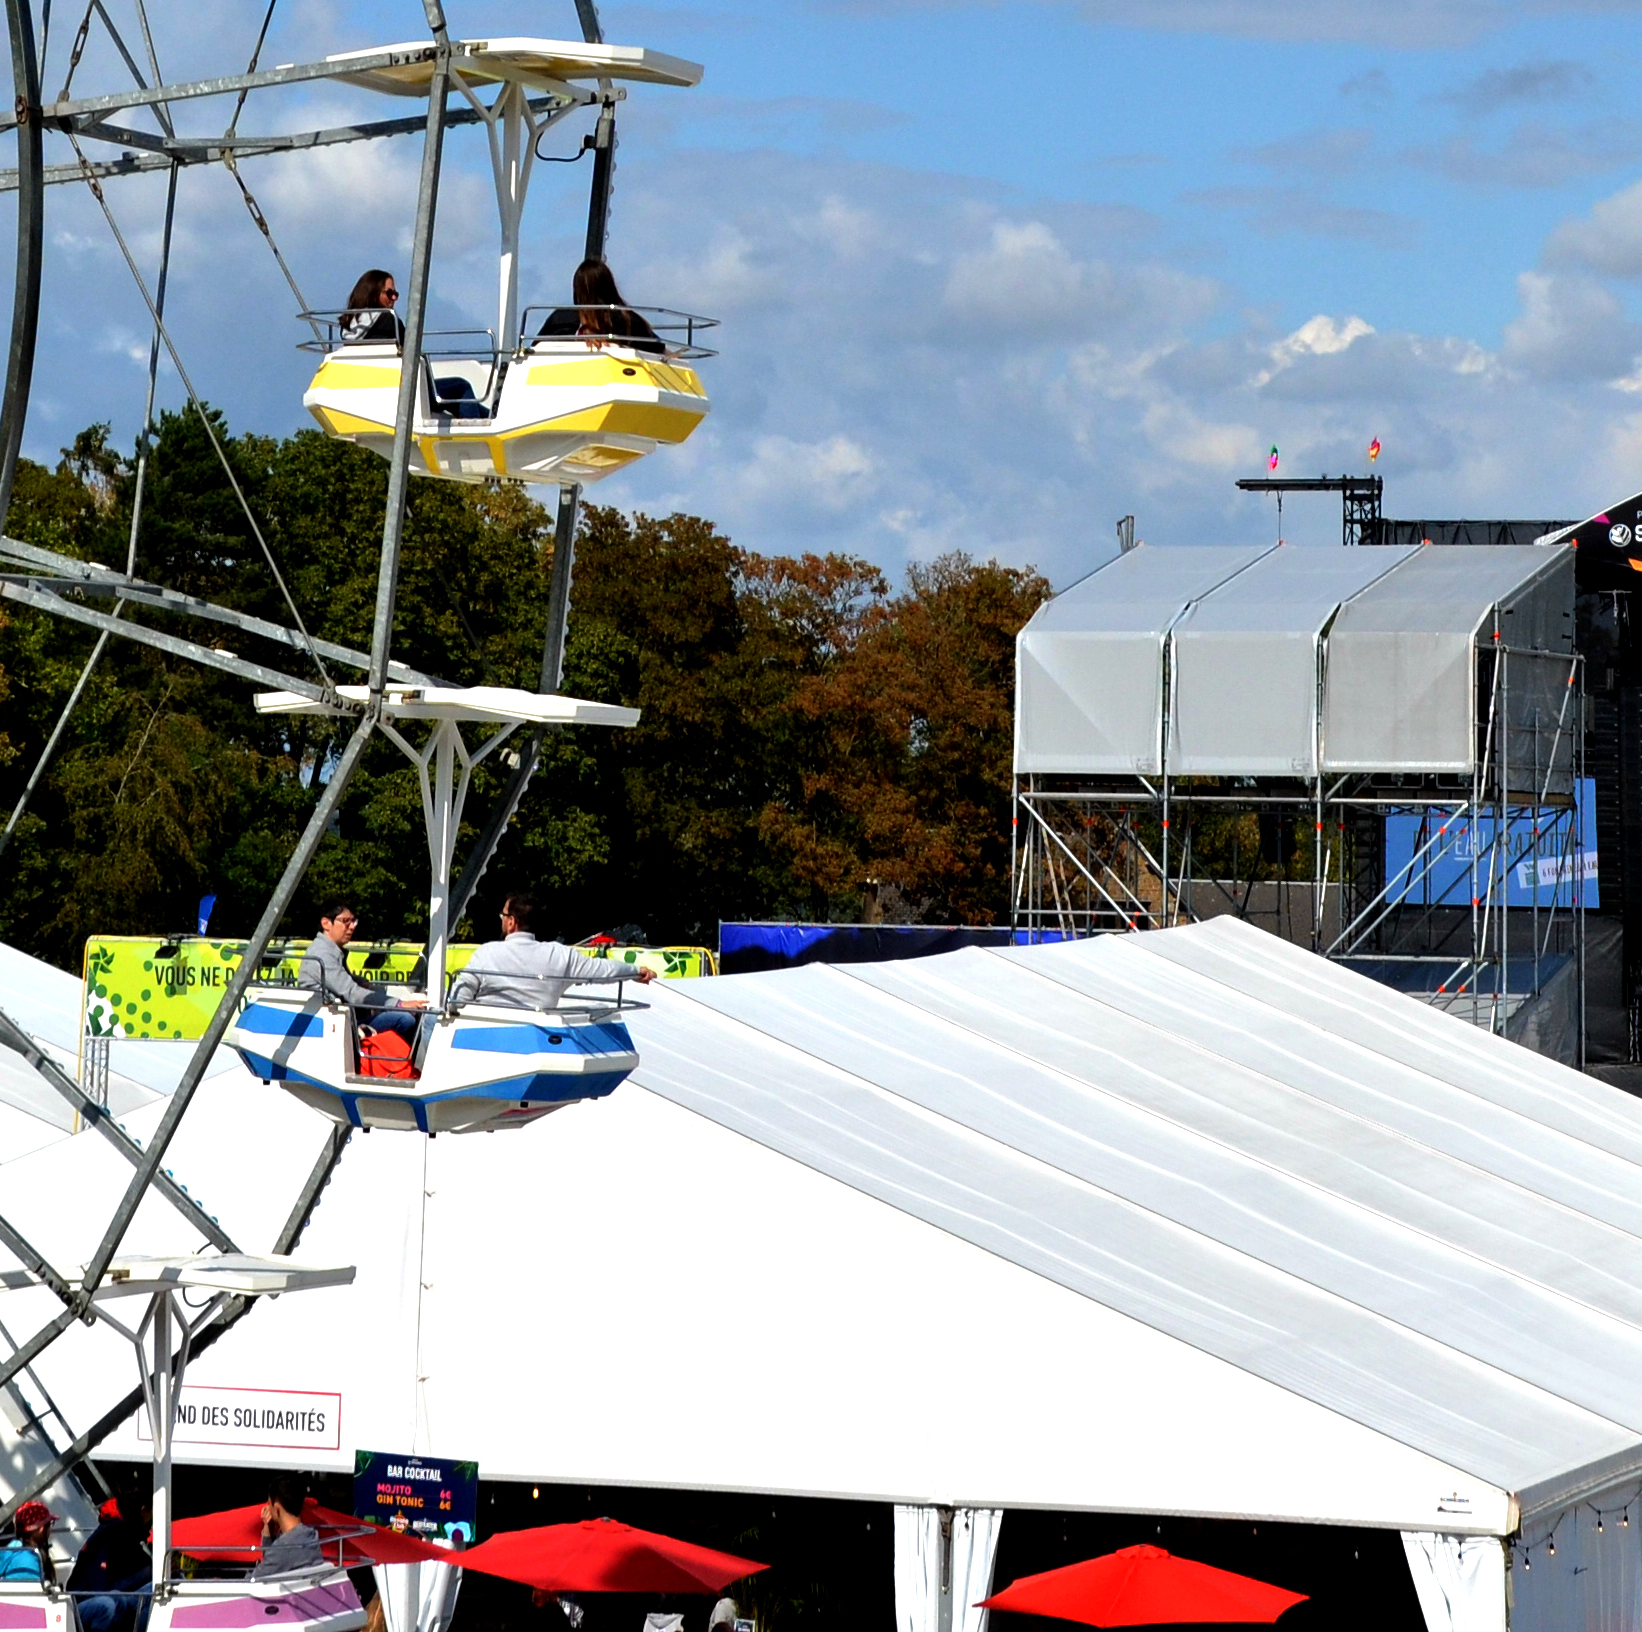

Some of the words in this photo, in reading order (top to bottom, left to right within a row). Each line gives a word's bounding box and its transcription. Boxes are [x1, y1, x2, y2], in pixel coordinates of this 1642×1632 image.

[155, 965, 196, 986] VOUS
[201, 966, 220, 986] NE
[202, 1406, 229, 1426] DES
[234, 1407, 326, 1433] SOLIDARITÉS
[387, 1464, 402, 1479] BAR
[404, 1466, 442, 1482] COCKTAIL
[377, 1483, 412, 1496] MOJITO
[376, 1494, 393, 1506] GIN
[395, 1496, 424, 1508] TONIC
